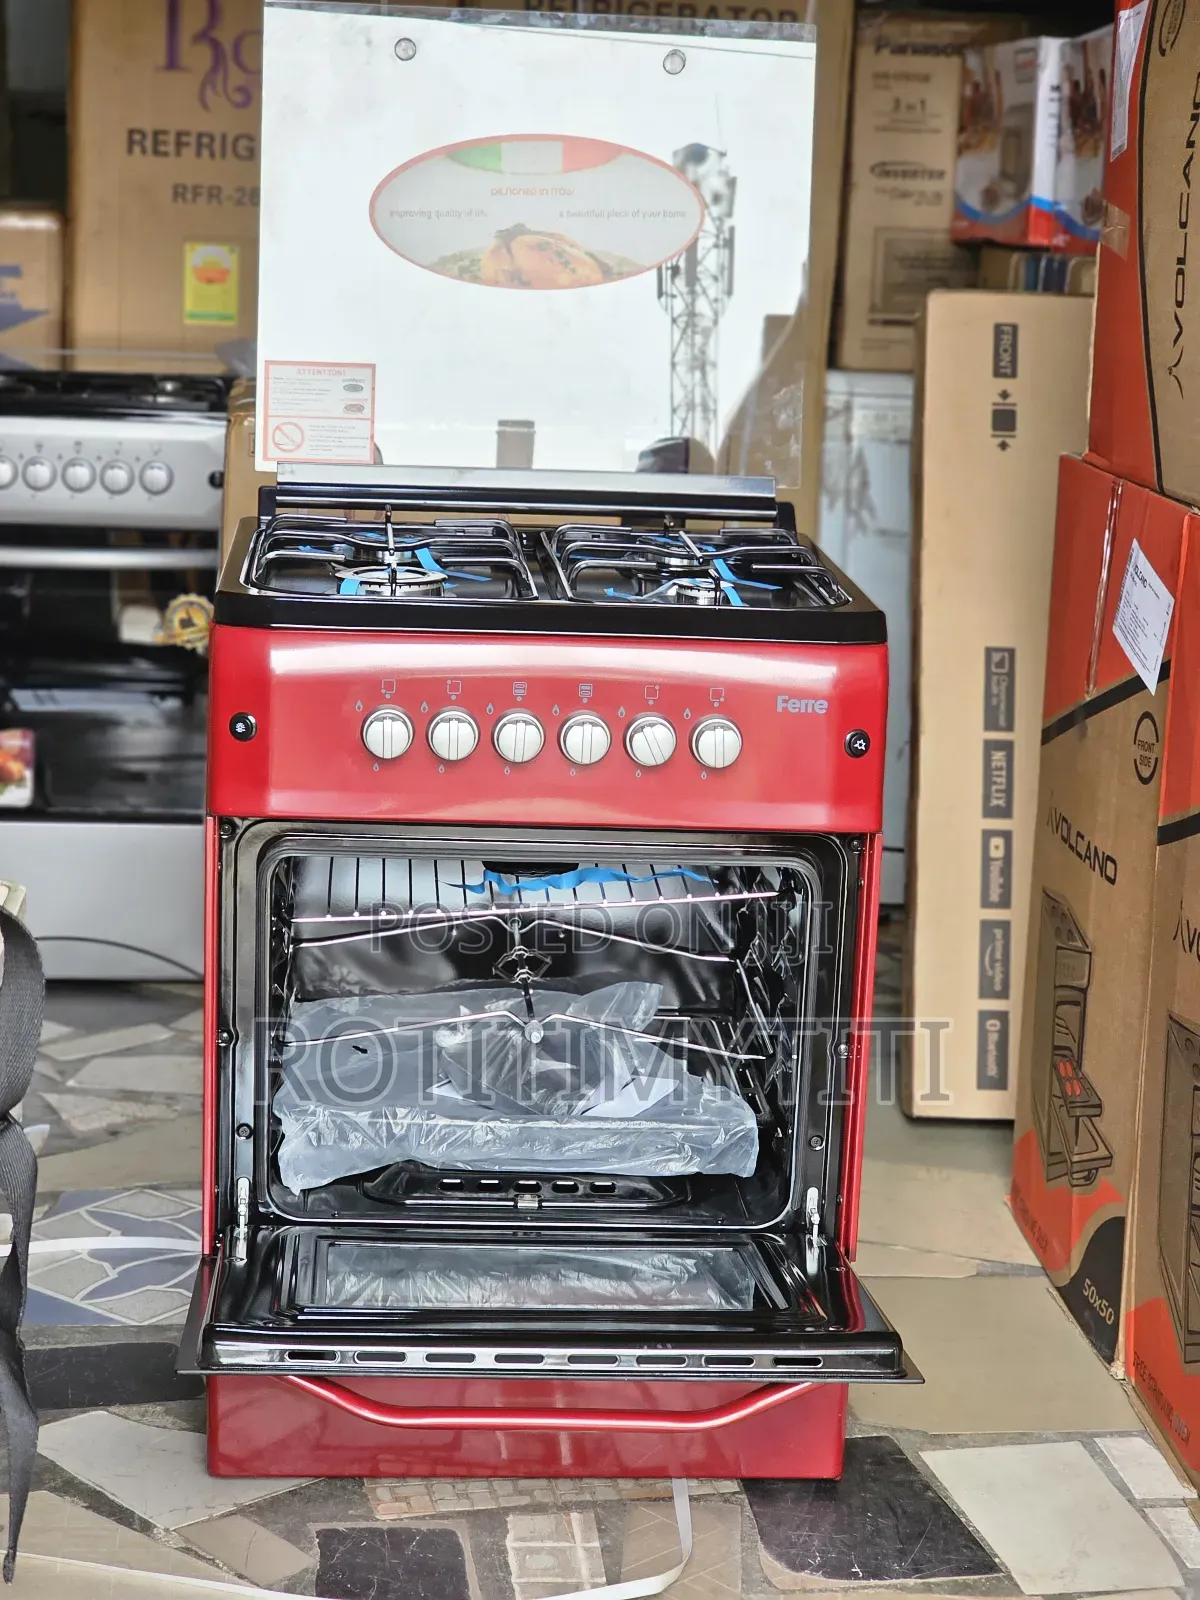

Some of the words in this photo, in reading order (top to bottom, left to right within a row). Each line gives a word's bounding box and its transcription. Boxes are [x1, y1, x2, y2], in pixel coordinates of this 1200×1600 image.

[126, 127, 257, 161] REFRIG
[631, 209, 640, 218] of
[642, 210, 661, 220] your
[1000, 326, 1012, 376] FRONT
[776, 695, 829, 714] Ferre
[1138, 740, 1155, 753] FRONT
[1139, 754, 1152, 768] SIDE
[990, 751, 1007, 807] NETFLIX
[1054, 807, 1118, 886] VOLCANO
[993, 928, 1004, 960] prime
[993, 961, 1004, 992] video
[1083, 1278, 1115, 1325] 50x50
